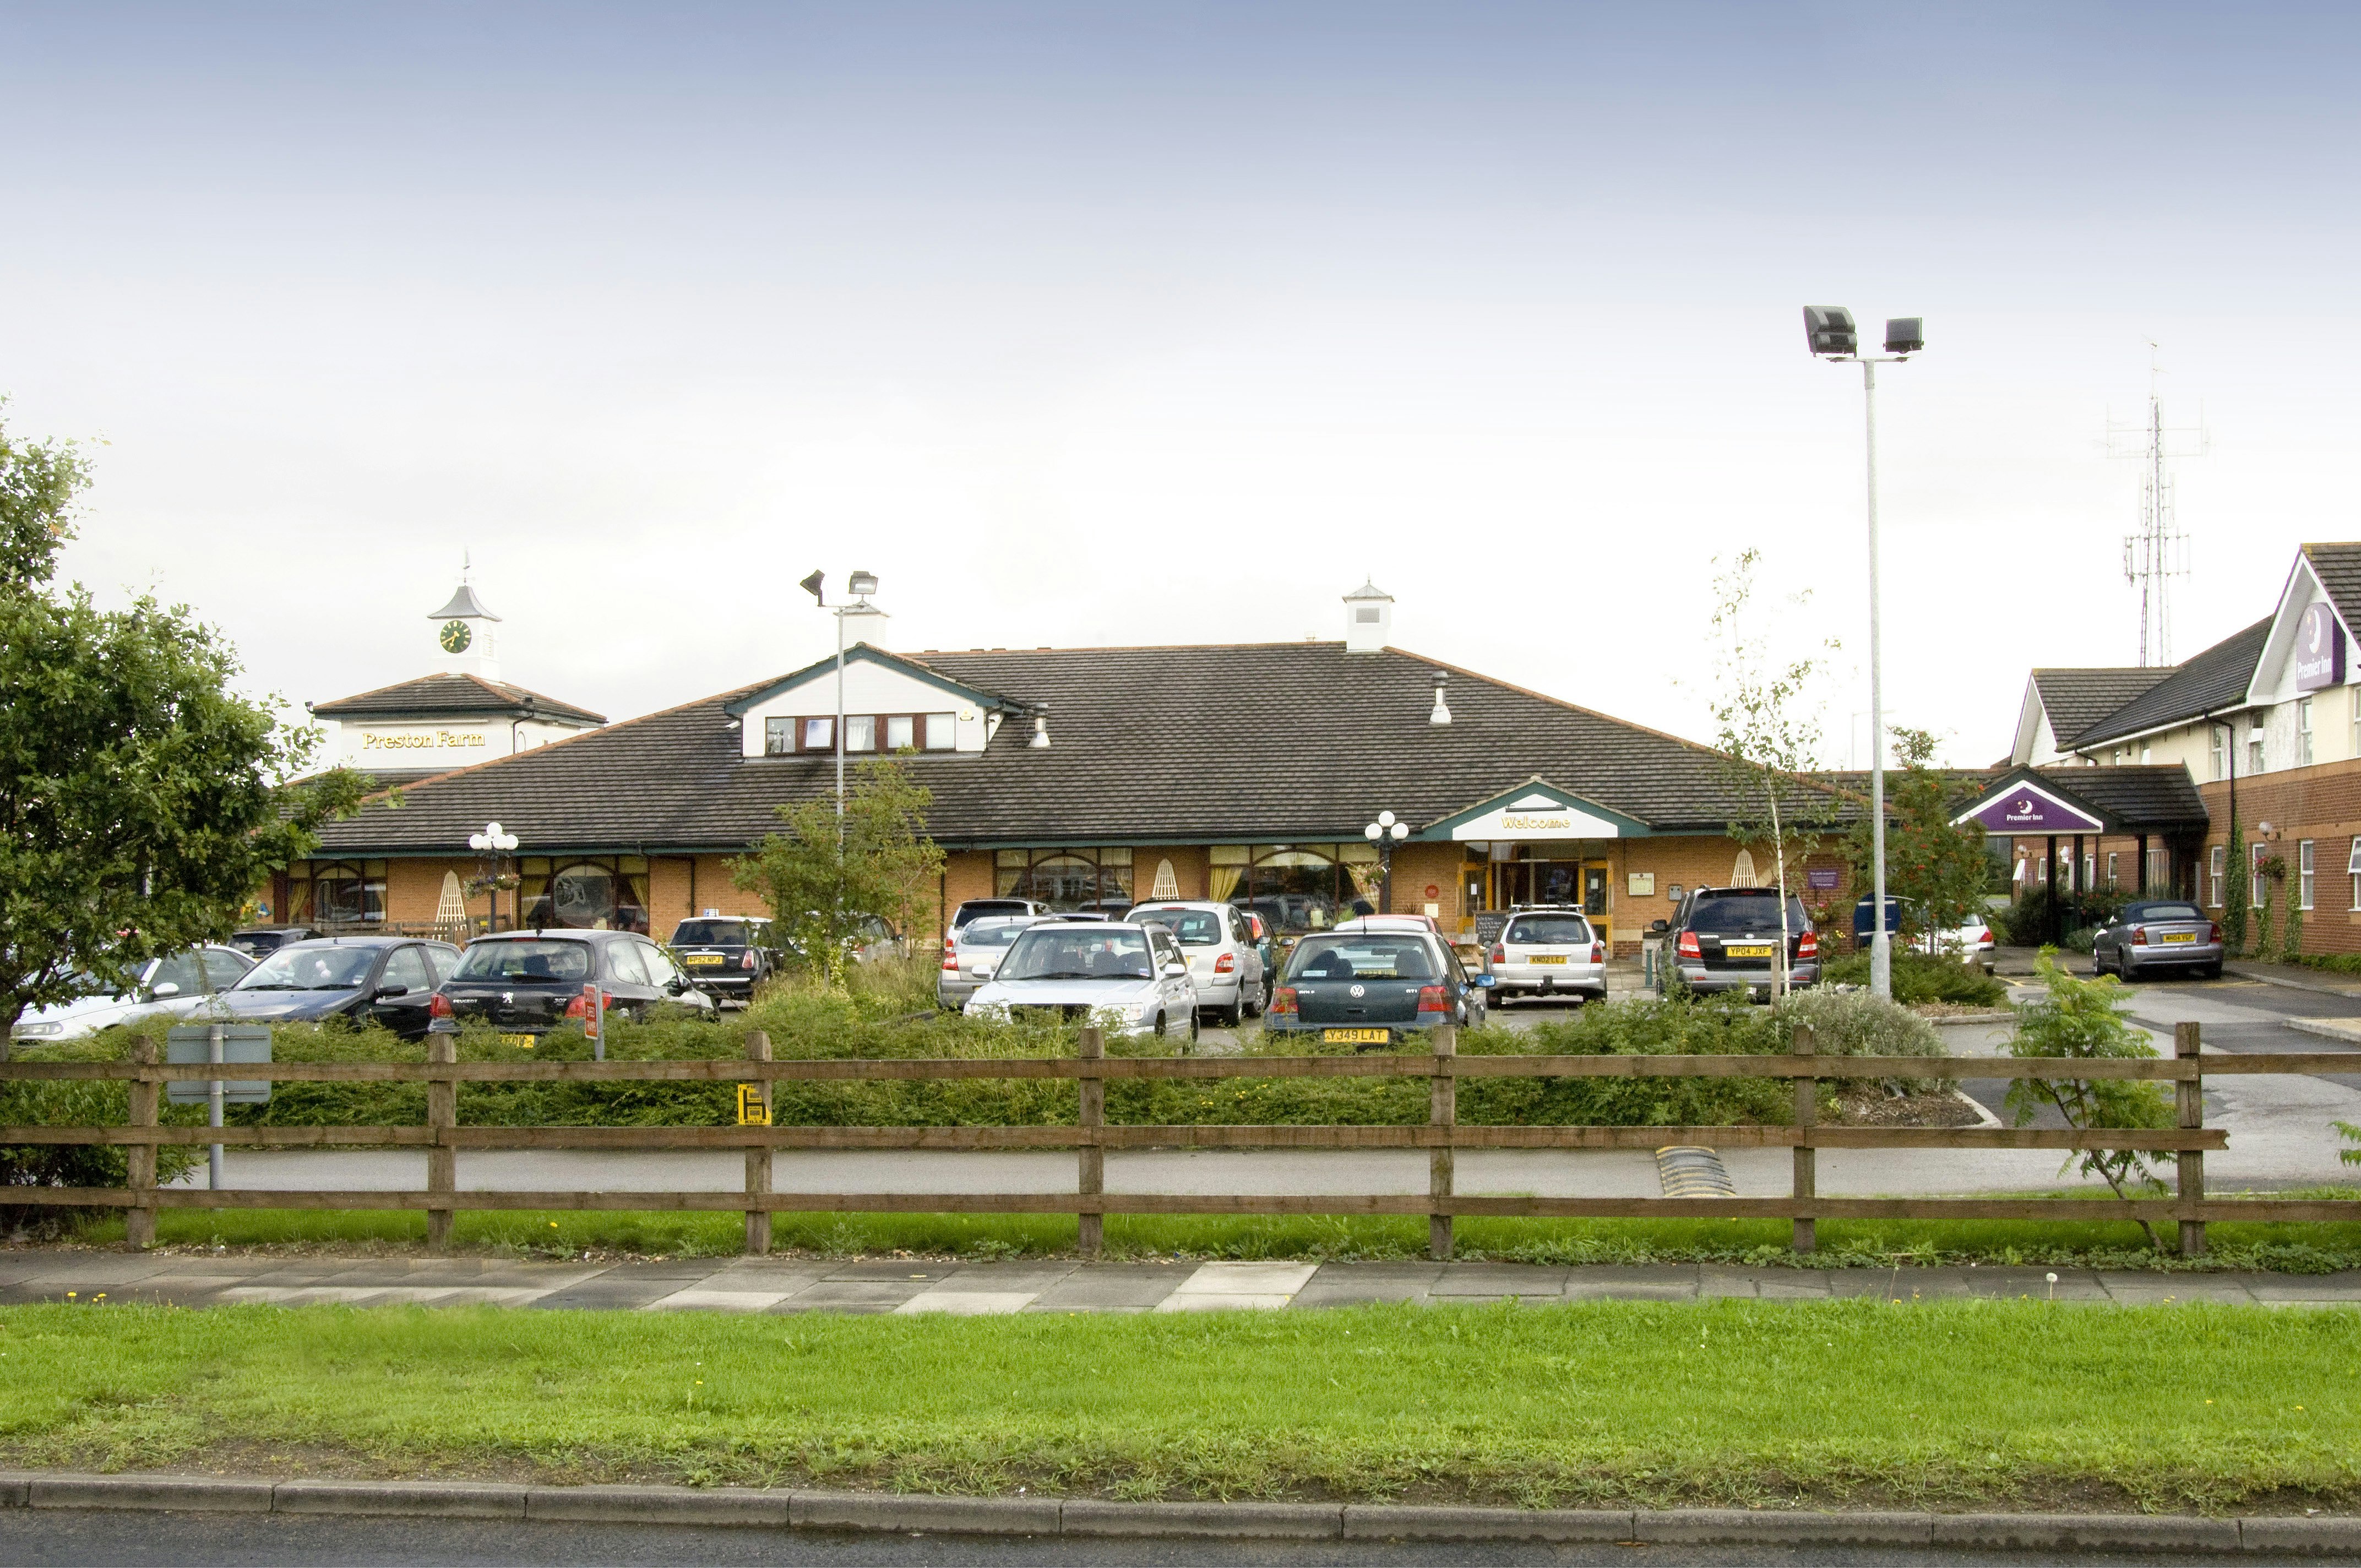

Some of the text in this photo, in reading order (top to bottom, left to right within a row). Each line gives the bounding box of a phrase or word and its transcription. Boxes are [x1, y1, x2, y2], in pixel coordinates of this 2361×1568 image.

[2297, 655, 2332, 679] Premier Inn
[363, 731, 486, 749] Preston Farm
[1501, 815, 1570, 829] Welcome
[1330, 1030, 1383, 1040] Y349 LAT
